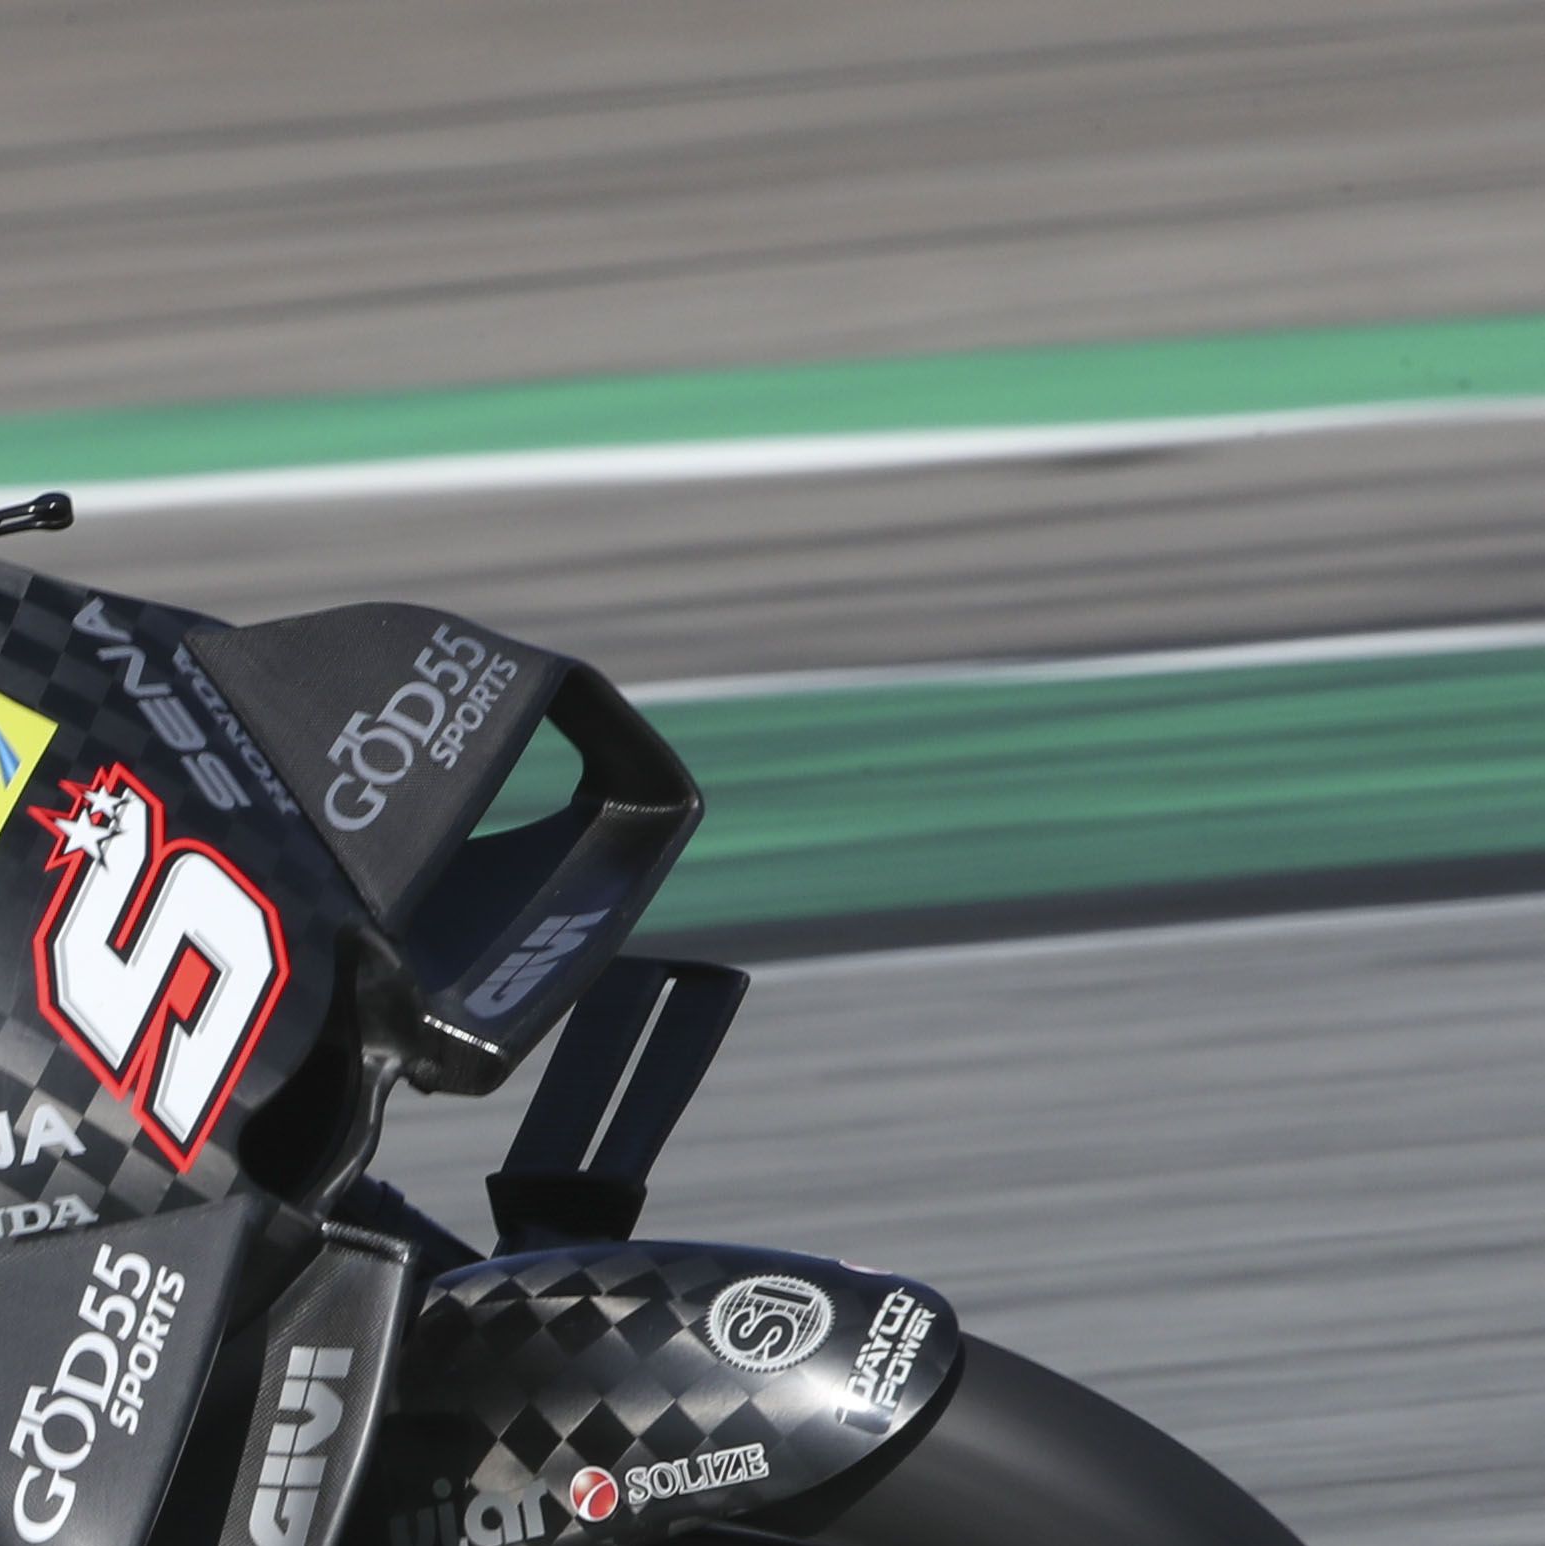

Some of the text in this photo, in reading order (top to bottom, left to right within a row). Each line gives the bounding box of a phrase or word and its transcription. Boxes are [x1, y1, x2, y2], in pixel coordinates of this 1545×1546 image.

[72, 597, 252, 811] SENA
[429, 652, 519, 770] SPORTS
[108, 1265, 186, 1435] SPORTS
[874, 1303, 937, 1408] POWER
[625, 1442, 770, 1505] SOLIZE
